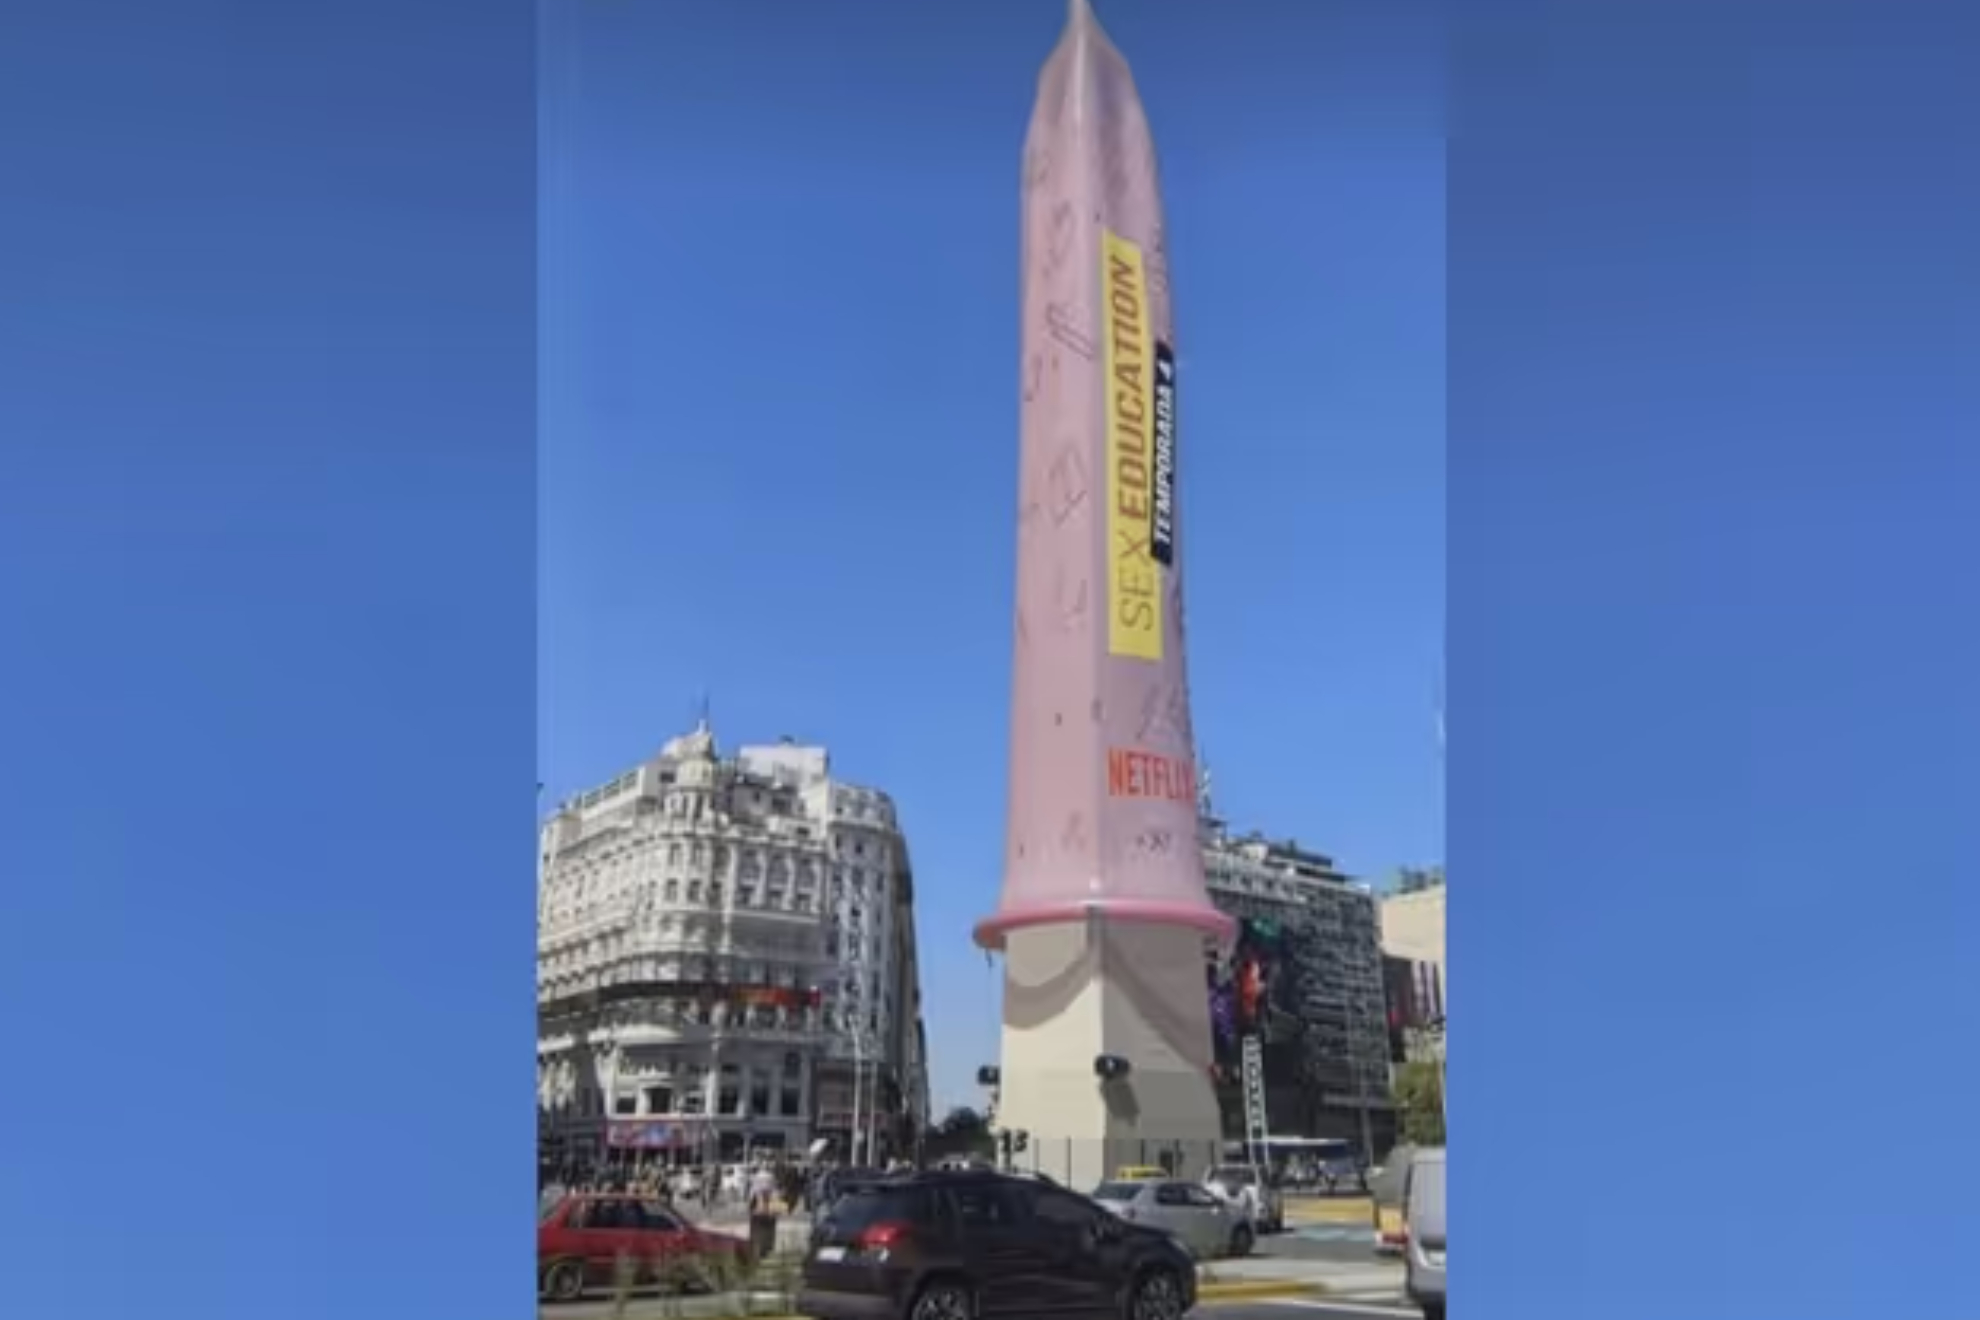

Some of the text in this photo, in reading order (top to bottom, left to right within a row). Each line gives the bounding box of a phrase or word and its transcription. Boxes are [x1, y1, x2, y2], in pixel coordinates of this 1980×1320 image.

[1111, 253, 1155, 632] SEX EDUCATION
[1156, 384, 1174, 546] TEMPORADA
